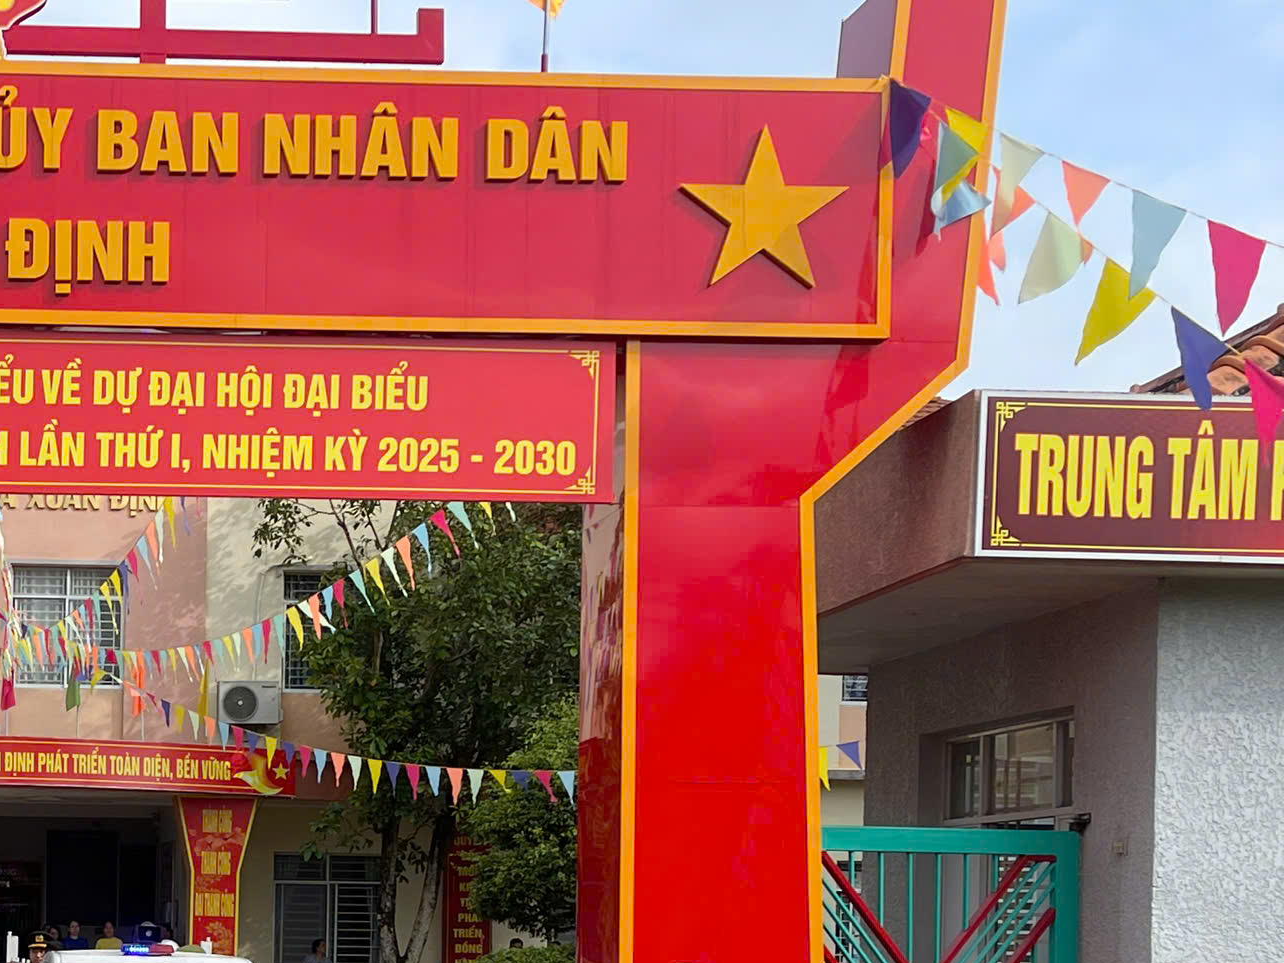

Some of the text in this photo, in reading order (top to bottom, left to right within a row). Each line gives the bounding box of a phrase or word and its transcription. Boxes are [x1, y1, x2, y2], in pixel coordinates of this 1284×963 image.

[98, 110, 237, 173] BAN
[264, 103, 457, 177] NHÂN
[488, 107, 627, 181] DÂN
[6, 219, 169, 294] ĐỊNH
[41, 356, 83, 405] VỀ
[93, 367, 142, 414] DỰ
[148, 371, 205, 415] ĐẠI
[217, 365, 273, 417] HỘI
[283, 373, 341, 417] ĐẠI
[351, 361, 429, 411] BIỂU
[19, 419, 85, 467] LẦN
[96, 425, 165, 468] THỨ
[171, 433, 191, 473] I,
[203, 427, 313, 479] NHIỆM
[324, 428, 368, 472] KỲ
[377, 437, 459, 473] 2025
[471, 455, 483, 463] -
[493, 439, 576, 476] 2030
[1014, 433, 1155, 519] TRUNG
[1167, 420, 1259, 520] TÂM
[4, 751, 34, 776] ĐỊNH
[37, 749, 69, 773] PHÁT
[72, 747, 107, 775] TRIỂN
[110, 752, 140, 776] TOÀN
[143, 753, 173, 782] DIỆN,
